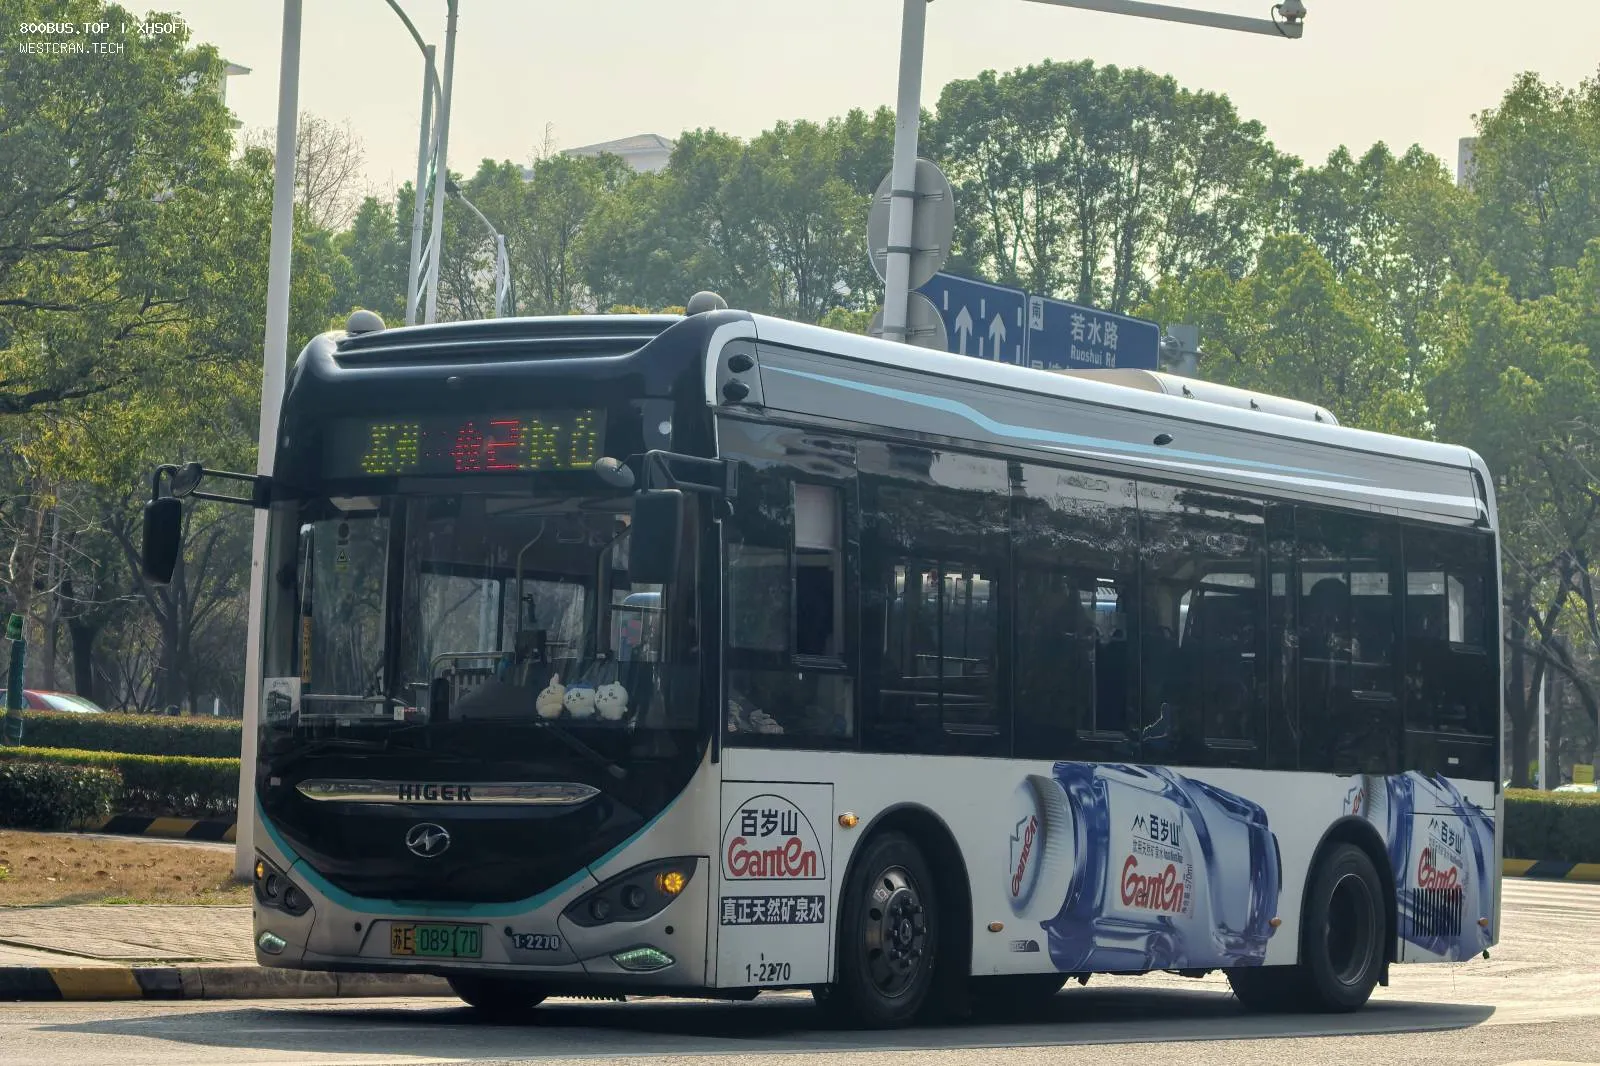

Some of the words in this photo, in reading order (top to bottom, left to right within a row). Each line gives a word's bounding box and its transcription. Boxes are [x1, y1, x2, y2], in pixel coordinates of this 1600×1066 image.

[1070, 313, 1118, 350] 若水路
[1071, 344, 1103, 366] Ruoshui
[1106, 352, 1116, 368] Rd
[399, 784, 472, 801] HIGER
[741, 808, 798, 837] 百岁山
[1150, 814, 1180, 847] 百岁山
[1441, 820, 1462, 855] 百岁山
[727, 837, 817, 877] Ganten
[1121, 854, 1184, 912] Ganten
[723, 898, 824, 925] 真正天然矿泉水
[745, 962, 791, 983] 1-2270
